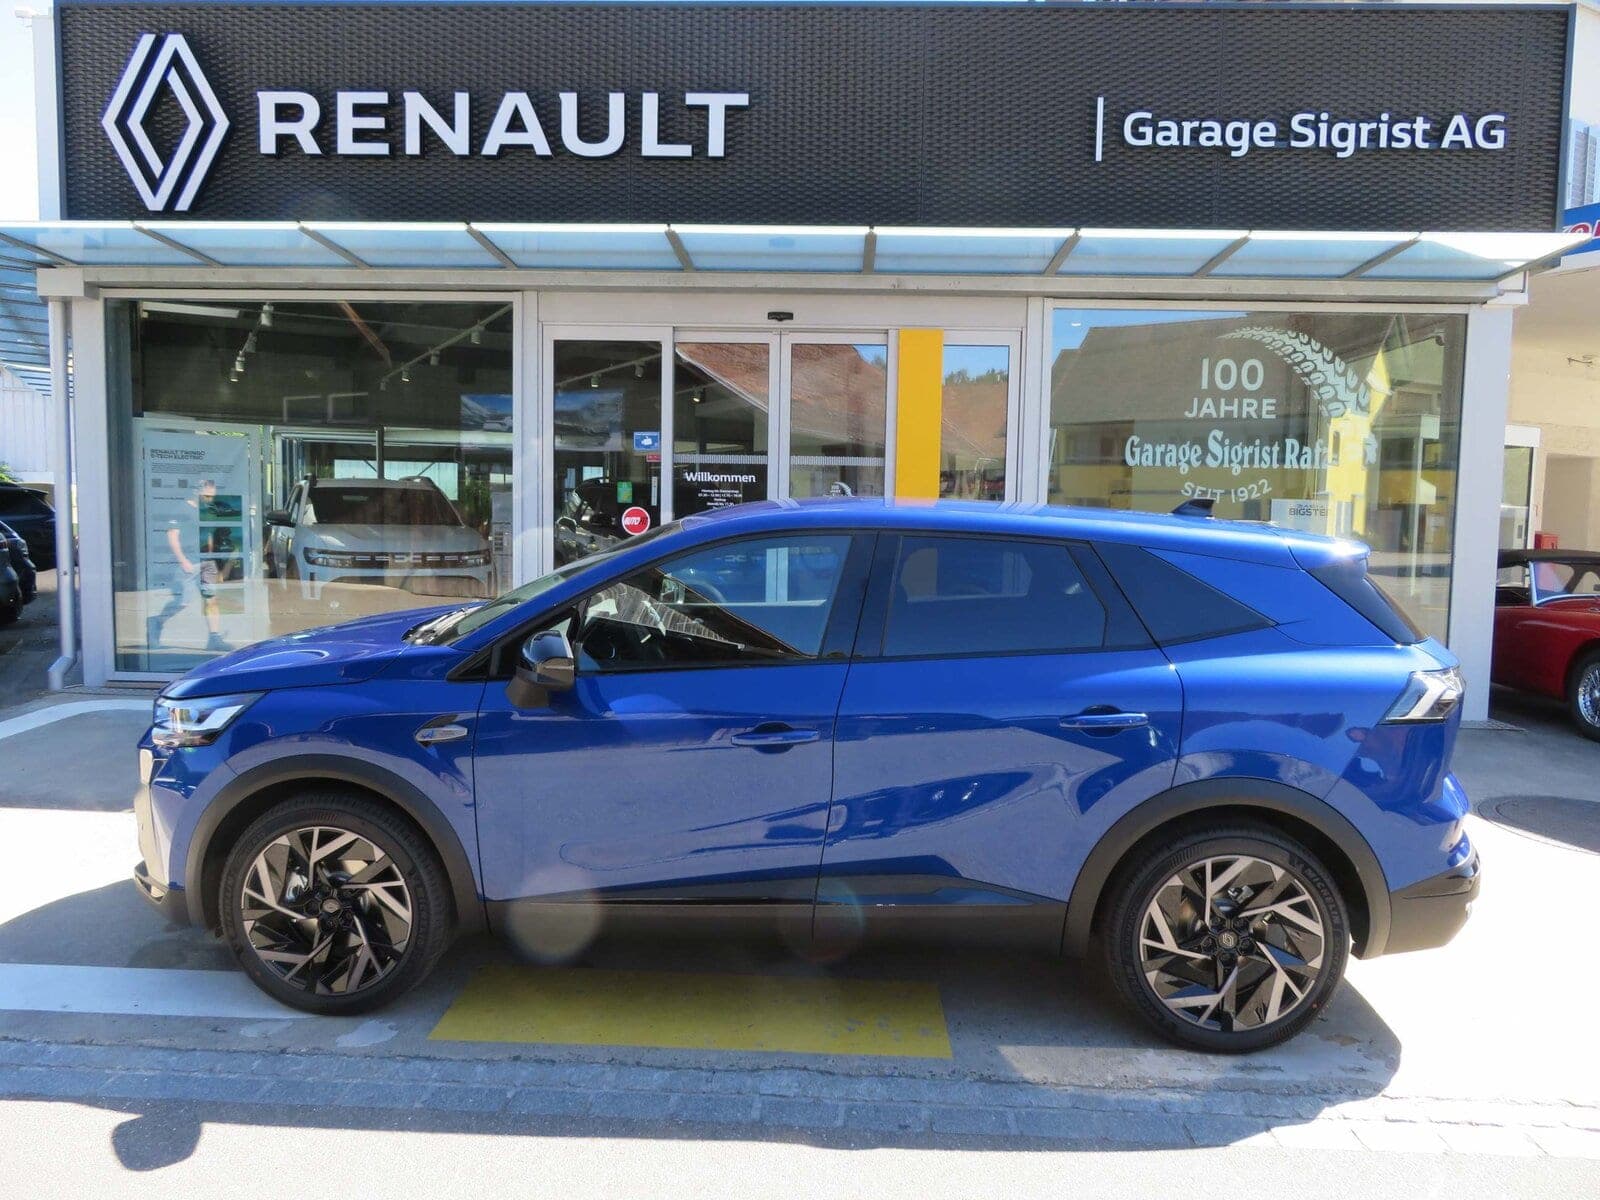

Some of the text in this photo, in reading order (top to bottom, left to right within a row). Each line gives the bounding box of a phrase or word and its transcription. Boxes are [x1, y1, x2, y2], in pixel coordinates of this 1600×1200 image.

[257, 91, 749, 157] RENAULT
[1123, 111, 1505, 158] Garage Sigrist AG
[1200, 358, 1264, 391] 100
[1184, 397, 1277, 420] JAHRE
[1125, 435, 1202, 475] Garage
[1205, 429, 1280, 476] Sigrist
[684, 471, 756, 483] Willkommen
[1181, 478, 1272, 504] SEIT 1922
